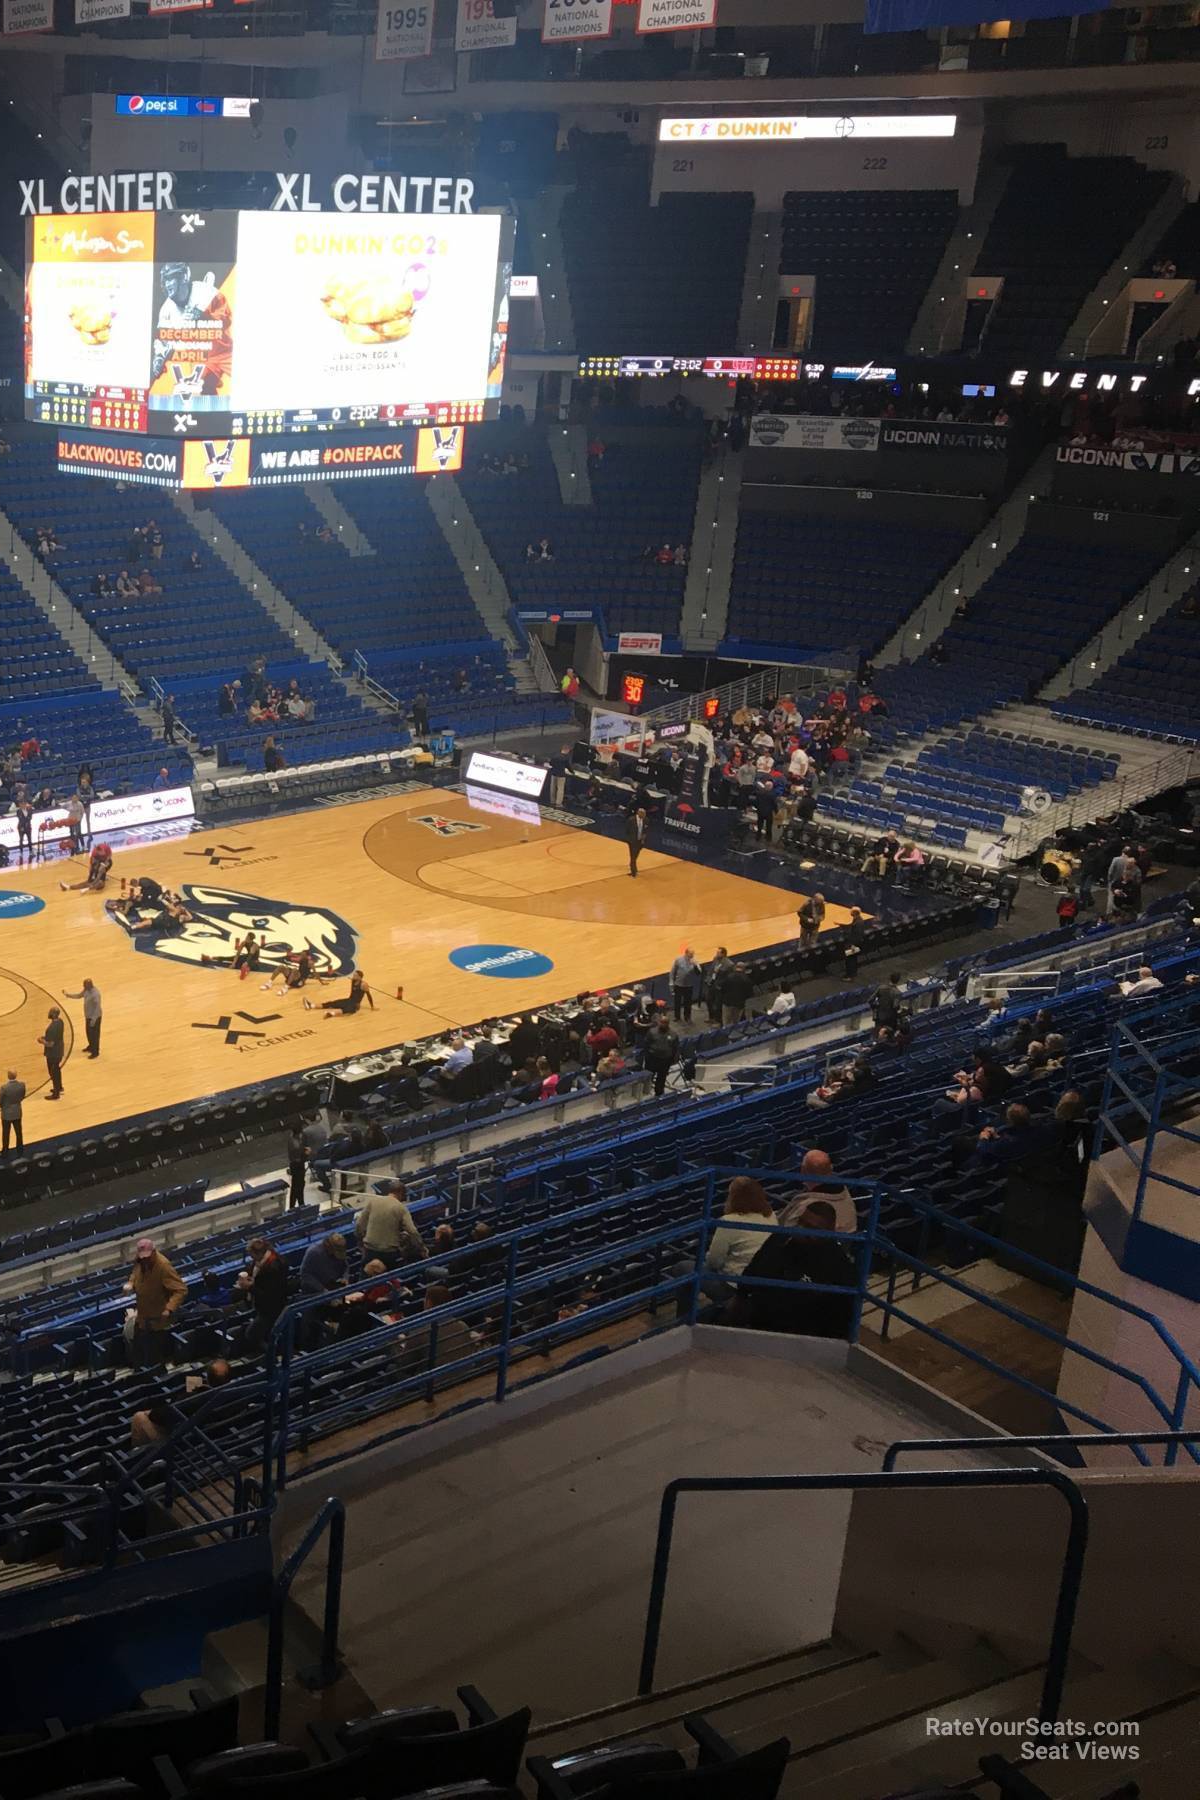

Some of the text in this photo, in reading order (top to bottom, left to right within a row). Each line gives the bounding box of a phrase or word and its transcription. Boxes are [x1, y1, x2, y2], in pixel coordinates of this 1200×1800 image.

[11, 2, 45, 15] NATIONAL
[80, 4, 124, 20] CHAMPIONS
[464, 0, 495, 21] 199
[651, 0, 704, 12] NATIONAL
[385, 7, 427, 30] 1995
[554, 9, 600, 22] NATIONAL
[646, 12, 706, 27] CHAMPIONS
[8, 16, 48, 31] CHAMPIONS
[465, 22, 507, 34] NATIONAL
[550, 23, 603, 37] CHAMPIONS
[460, 34, 510, 48] CHAMPIONS
[146, 100, 177, 112] pepsi
[669, 121, 798, 138] CT DUNKIN'
[1145, 136, 1169, 150] 223
[672, 160, 695, 172] 221
[863, 158, 887, 171] 222
[19, 172, 174, 214] XL CENTER
[275, 173, 475, 214] XL CENTER
[160, 329, 223, 340] DECEMBER
[172, 351, 207, 362] APRIL
[654, 359, 663, 369] 0
[673, 360, 702, 370] 23:02
[714, 360, 723, 369] 0
[805, 363, 825, 372] 6:30
[1010, 370, 1147, 392] EVENT
[332, 408, 341, 420] 0
[350, 405, 379, 420] 23:02
[387, 405, 395, 418] 0
[884, 430, 940, 445] UCONN
[58, 441, 176, 473] BLACKWOLVES.COM
[261, 444, 403, 469] WE ARE #ONEPACK
[1056, 447, 1124, 467] UCONN
[856, 490, 873, 500] 120
[1093, 512, 1110, 521] 121
[620, 638, 660, 649] ESPN
[626, 687, 641, 702] 30
[660, 724, 686, 737] UCONN
[164, 797, 186, 807] UCONN
[94, 807, 126, 819] KeyBank
[465, 949, 535, 973] genius3D
[233, 1028, 318, 1053] XL CENTER
